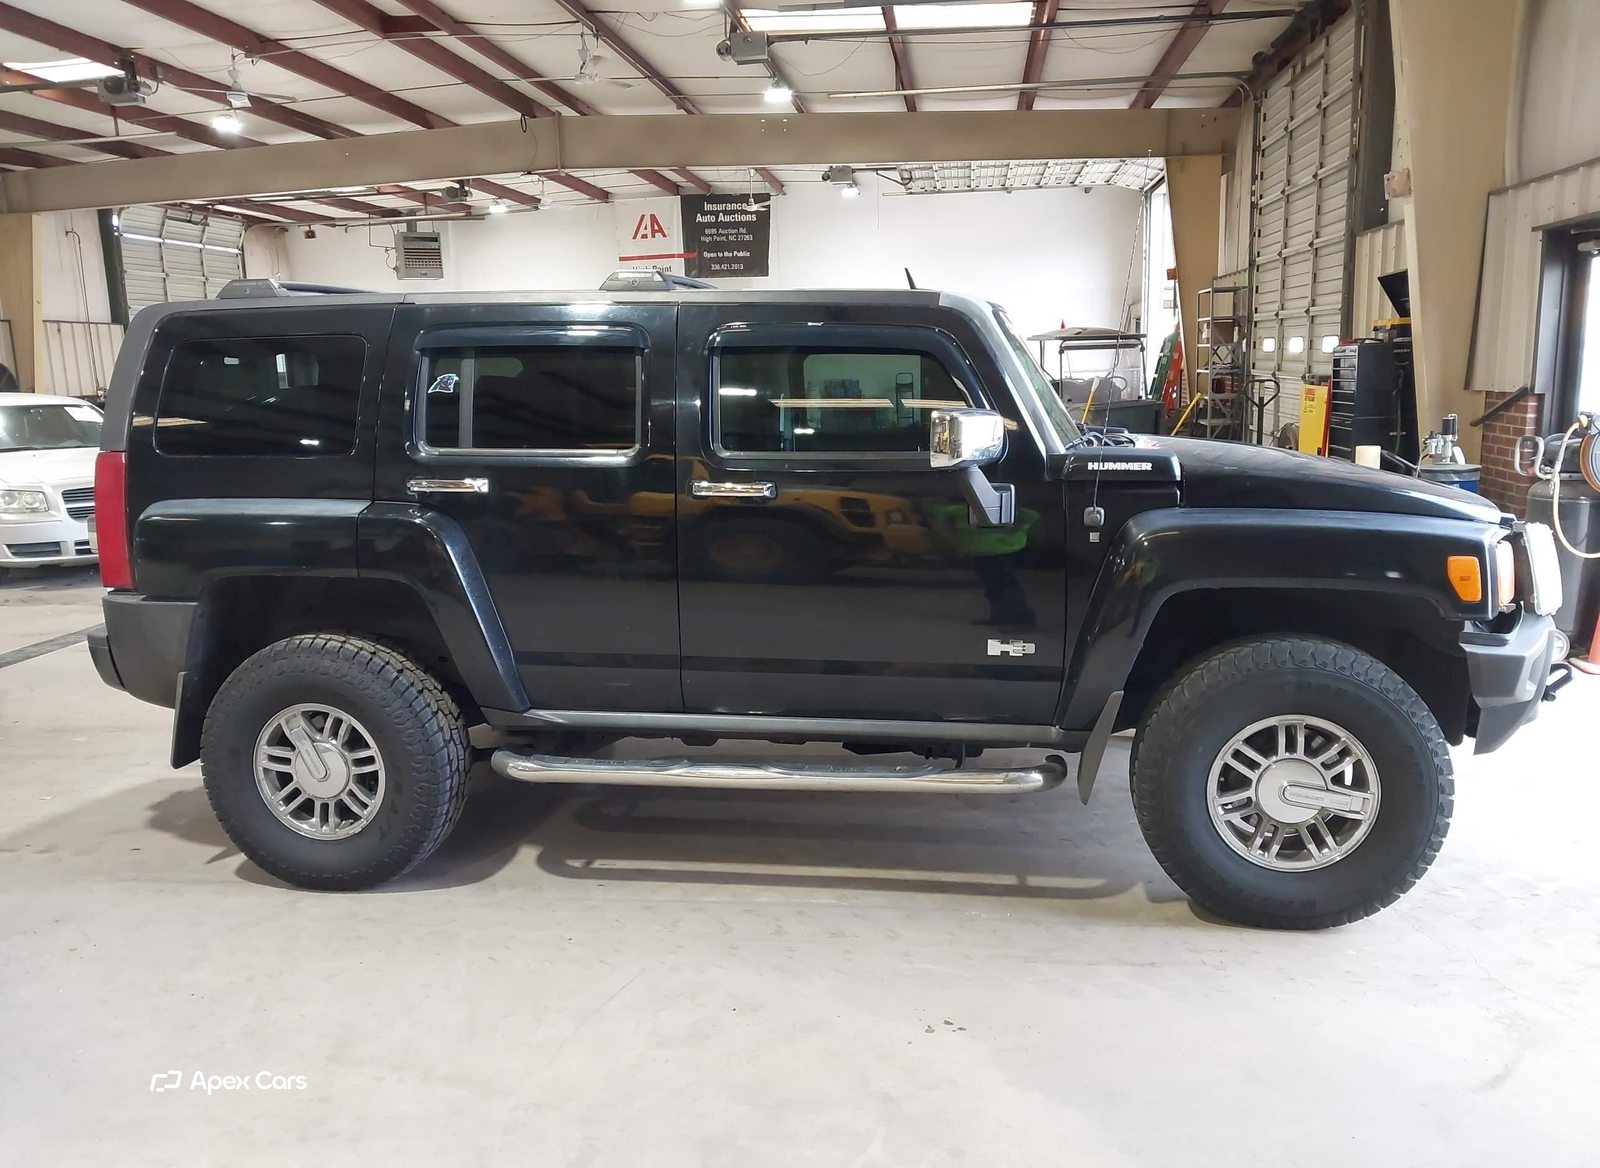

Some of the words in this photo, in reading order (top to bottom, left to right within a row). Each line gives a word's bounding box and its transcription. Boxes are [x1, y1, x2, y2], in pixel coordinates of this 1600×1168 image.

[704, 201, 748, 211] Insurance
[695, 213, 716, 223] Auto
[718, 212, 757, 222] Auctions
[700, 235, 713, 243] High
[703, 251, 717, 259] Open
[1087, 462, 1152, 471] HUMMER
[987, 638, 1036, 657] H3
